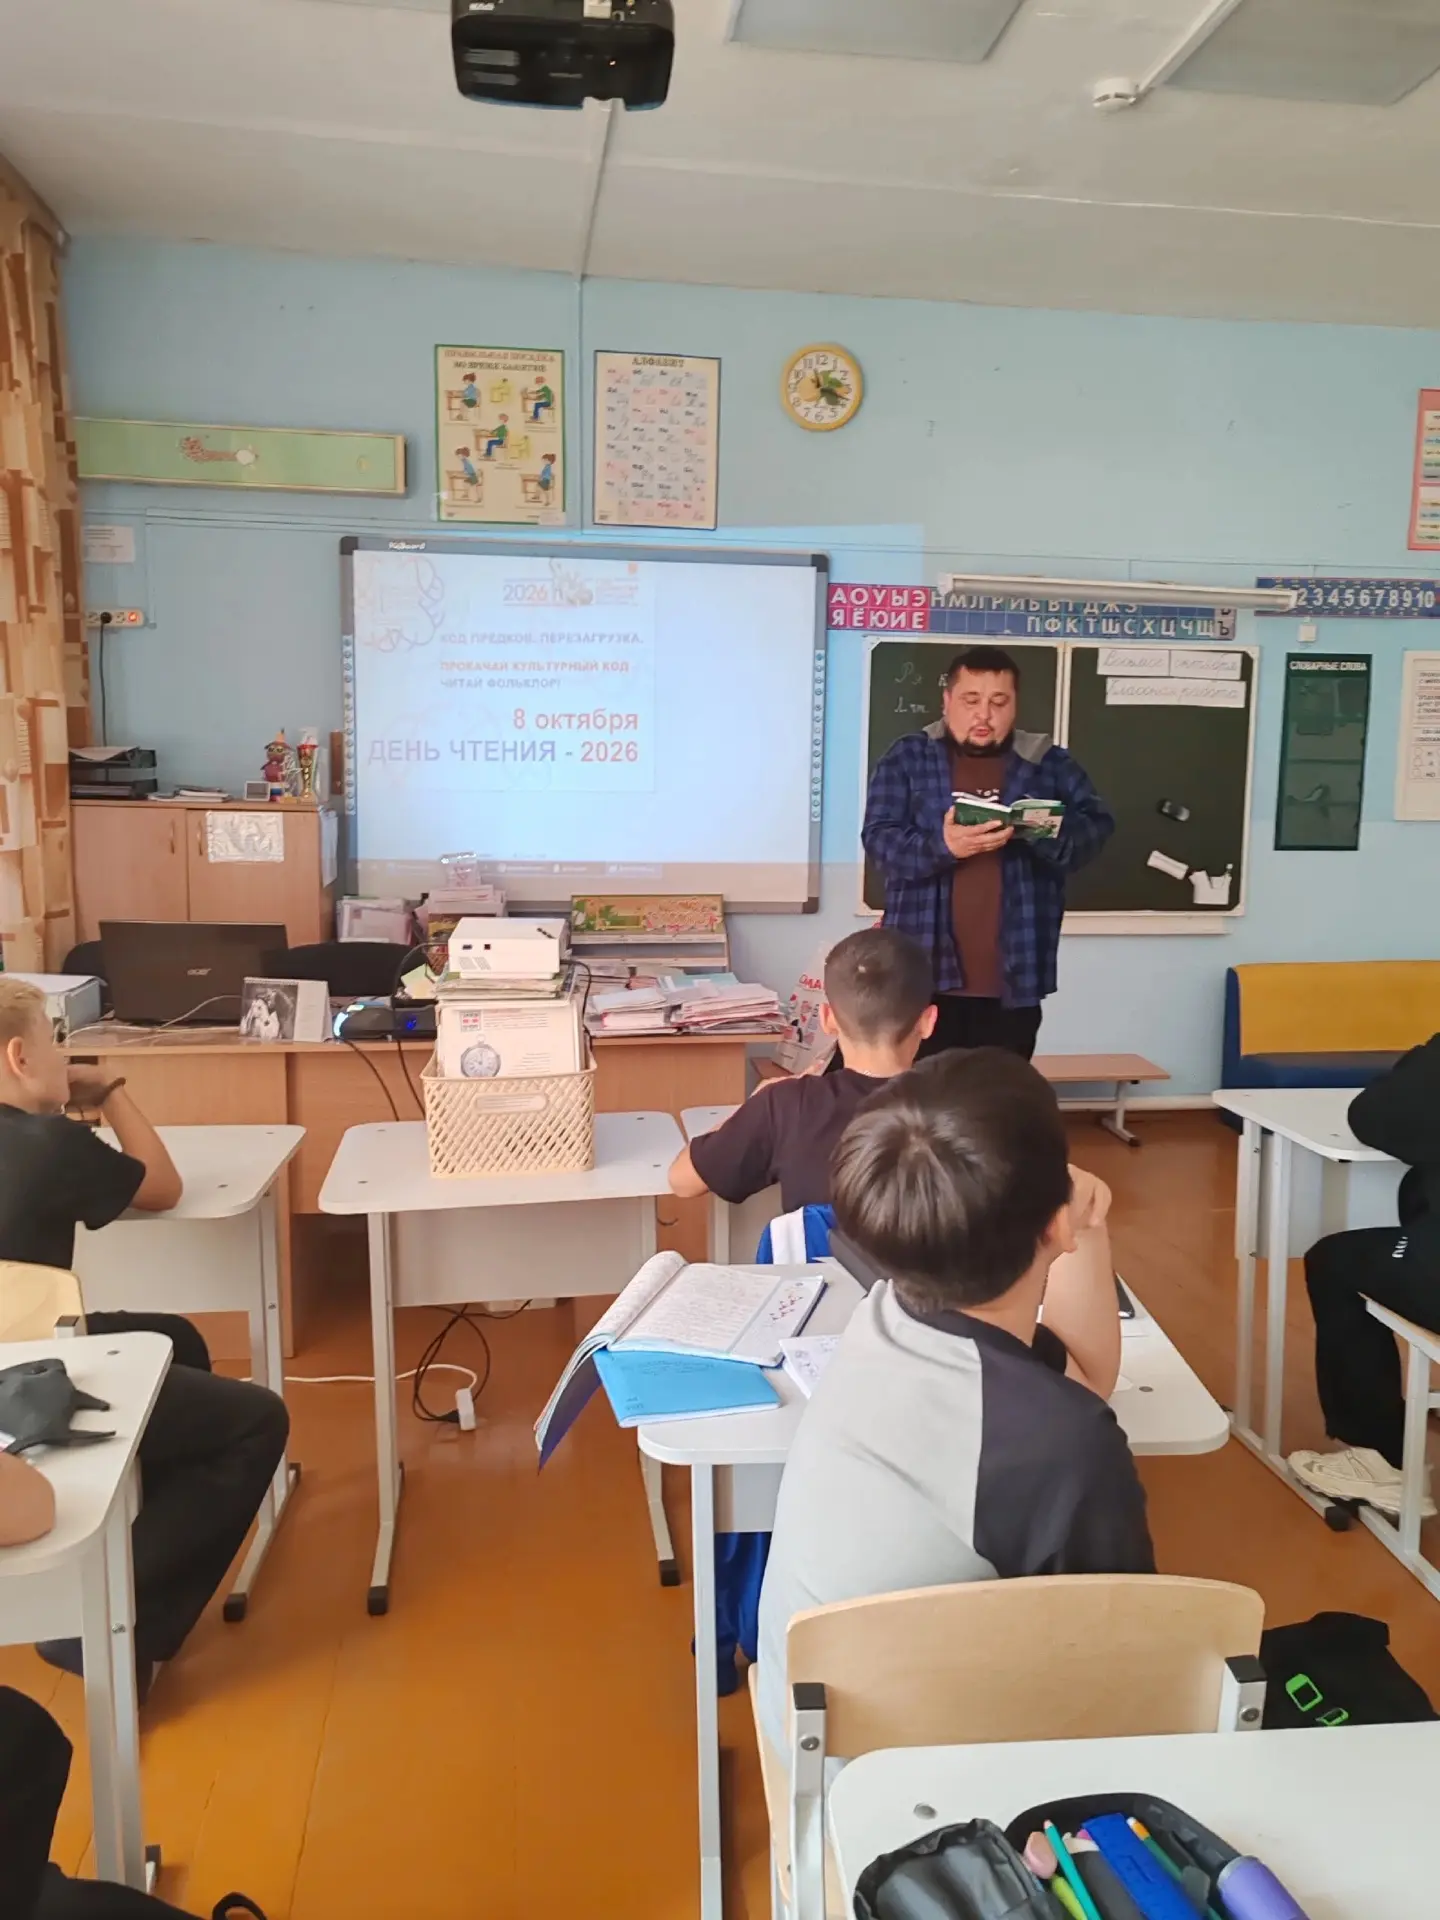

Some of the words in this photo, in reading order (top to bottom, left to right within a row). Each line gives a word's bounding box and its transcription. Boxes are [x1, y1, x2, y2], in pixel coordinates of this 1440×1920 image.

[816, 354, 828, 365] 12
[502, 583, 548, 602] 2026
[1298, 588, 1308, 606] 2
[1313, 588, 1323, 606] 3
[1328, 588, 1339, 606] 4
[1344, 589, 1355, 606] 5
[1359, 589, 1370, 607] 6
[1374, 589, 1385, 607] 7
[1389, 590, 1399, 607] 8
[1402, 590, 1412, 607] 9
[1417, 590, 1435, 608] 10
[440, 633, 467, 644] КОД
[512, 660, 598, 672] КУЛЬТУРНЫЙ
[602, 661, 629, 673] КОД
[1341, 661, 1367, 671] СЛОВА
[440, 677, 483, 689] ЧИТАЙ
[512, 708, 525, 730] 8
[535, 708, 639, 735] октября
[368, 740, 441, 765] ДЕНЬ
[449, 740, 556, 762] ЧТЕНИЯ
[580, 740, 639, 763] 2026
[187, 967, 212, 977] acer
